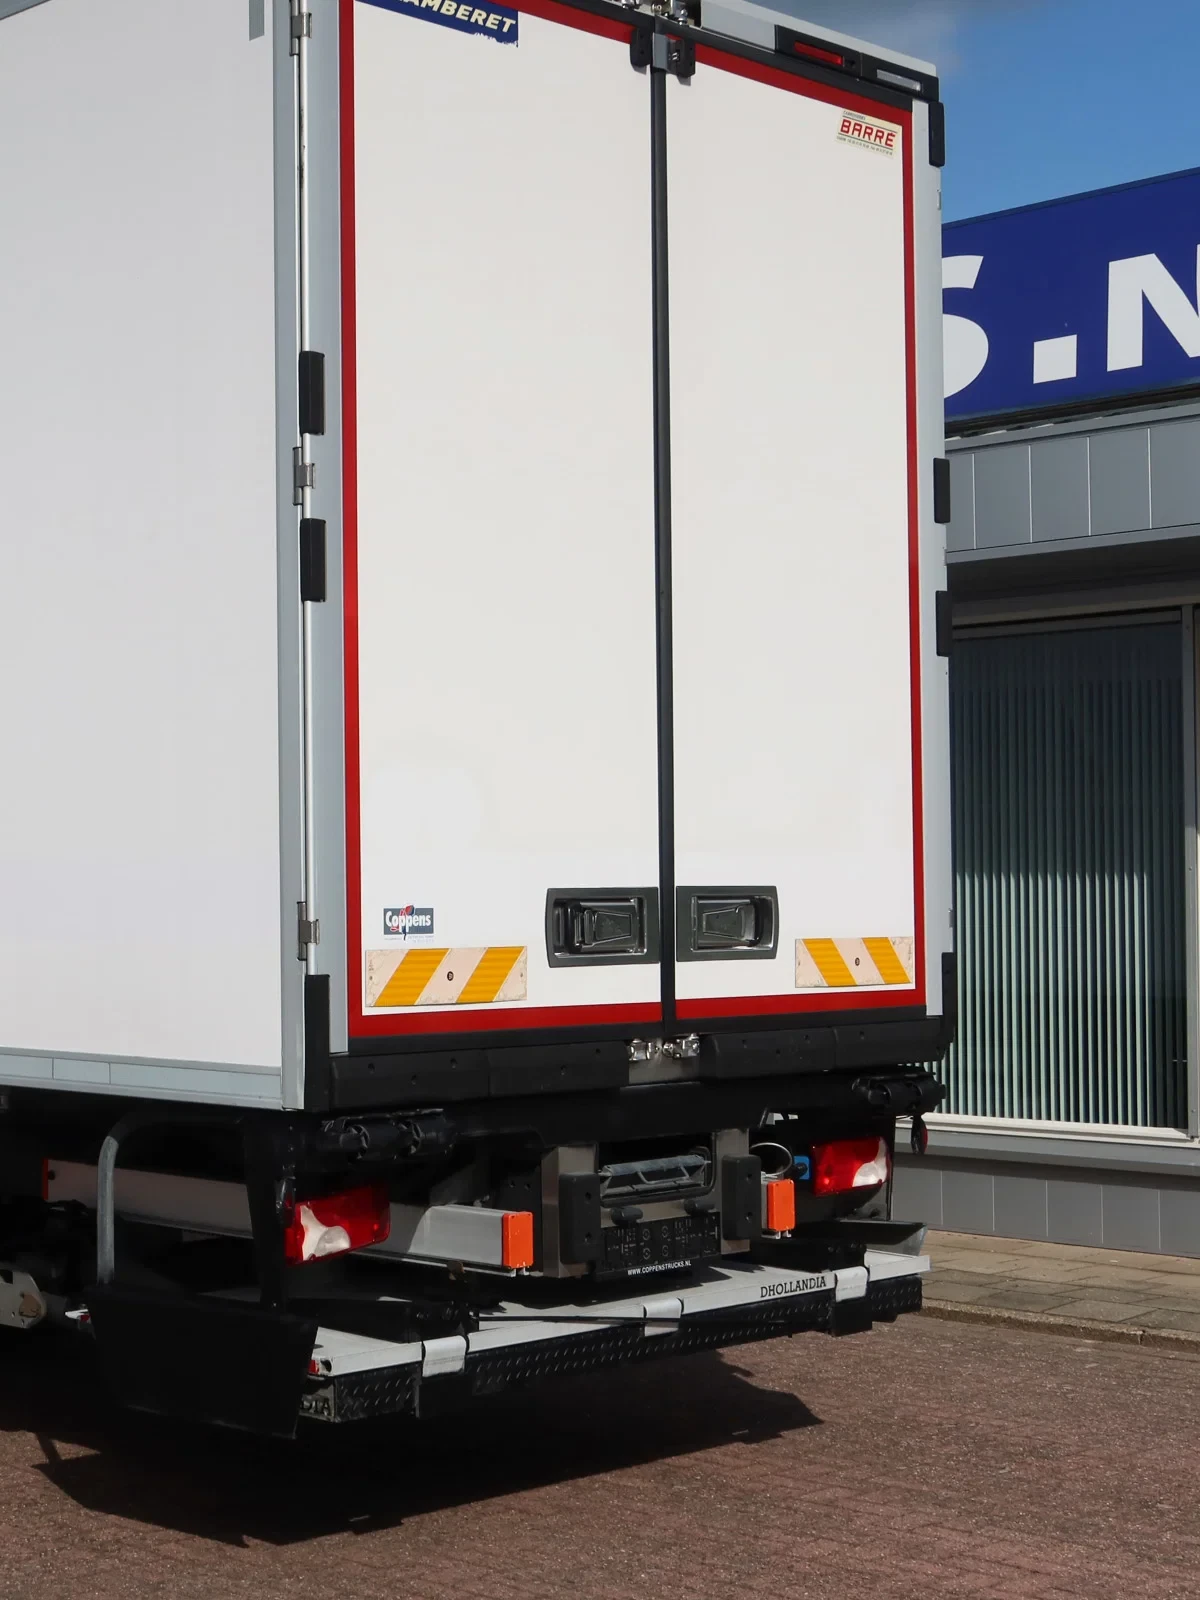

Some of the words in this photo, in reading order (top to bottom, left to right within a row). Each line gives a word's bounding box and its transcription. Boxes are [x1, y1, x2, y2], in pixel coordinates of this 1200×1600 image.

[399, 0, 516, 33] MBERET
[385, 910, 432, 933] Coppens
[627, 1260, 692, 1276] WWW.COPPENSTRUCKS.NL
[760, 1276, 827, 1298] DHOLLANDIA
